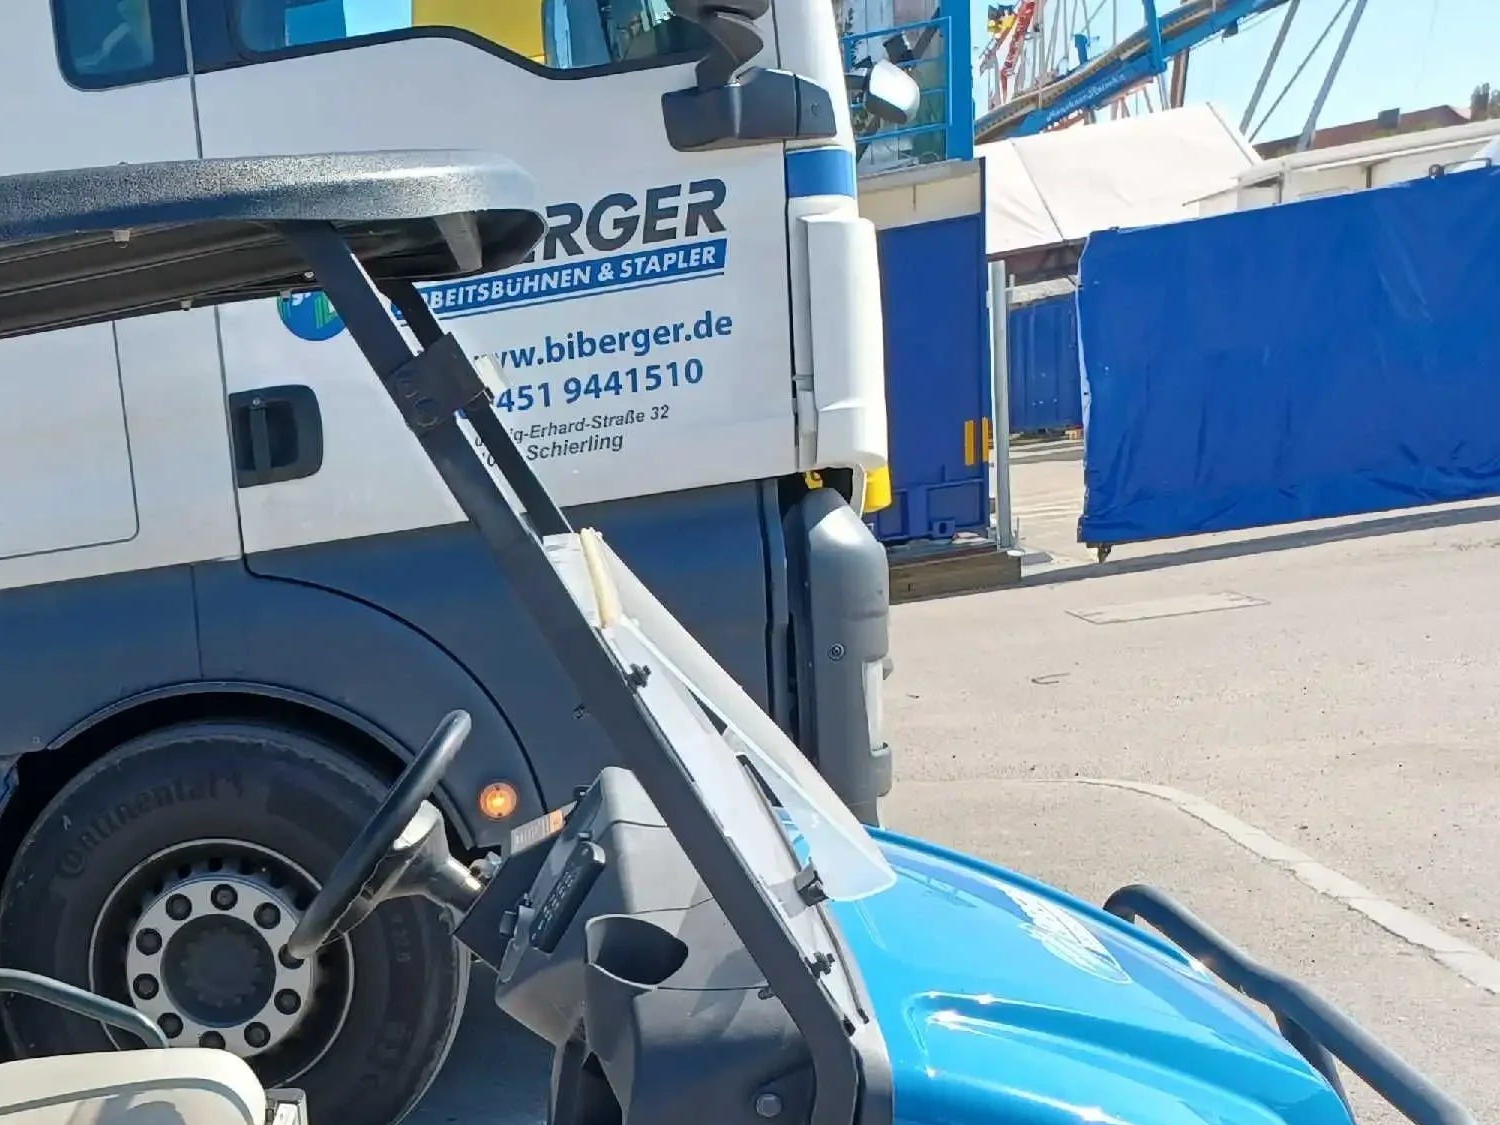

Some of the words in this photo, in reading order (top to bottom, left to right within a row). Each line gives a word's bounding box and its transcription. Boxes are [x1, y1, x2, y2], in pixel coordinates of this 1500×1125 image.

[524, 178, 728, 262] RGER
[597, 261, 614, 282] &
[619, 246, 716, 279] STAPLER
[563, 358, 704, 404] 9441510
[650, 404, 669, 420] 32
[526, 432, 623, 461] Schierling
